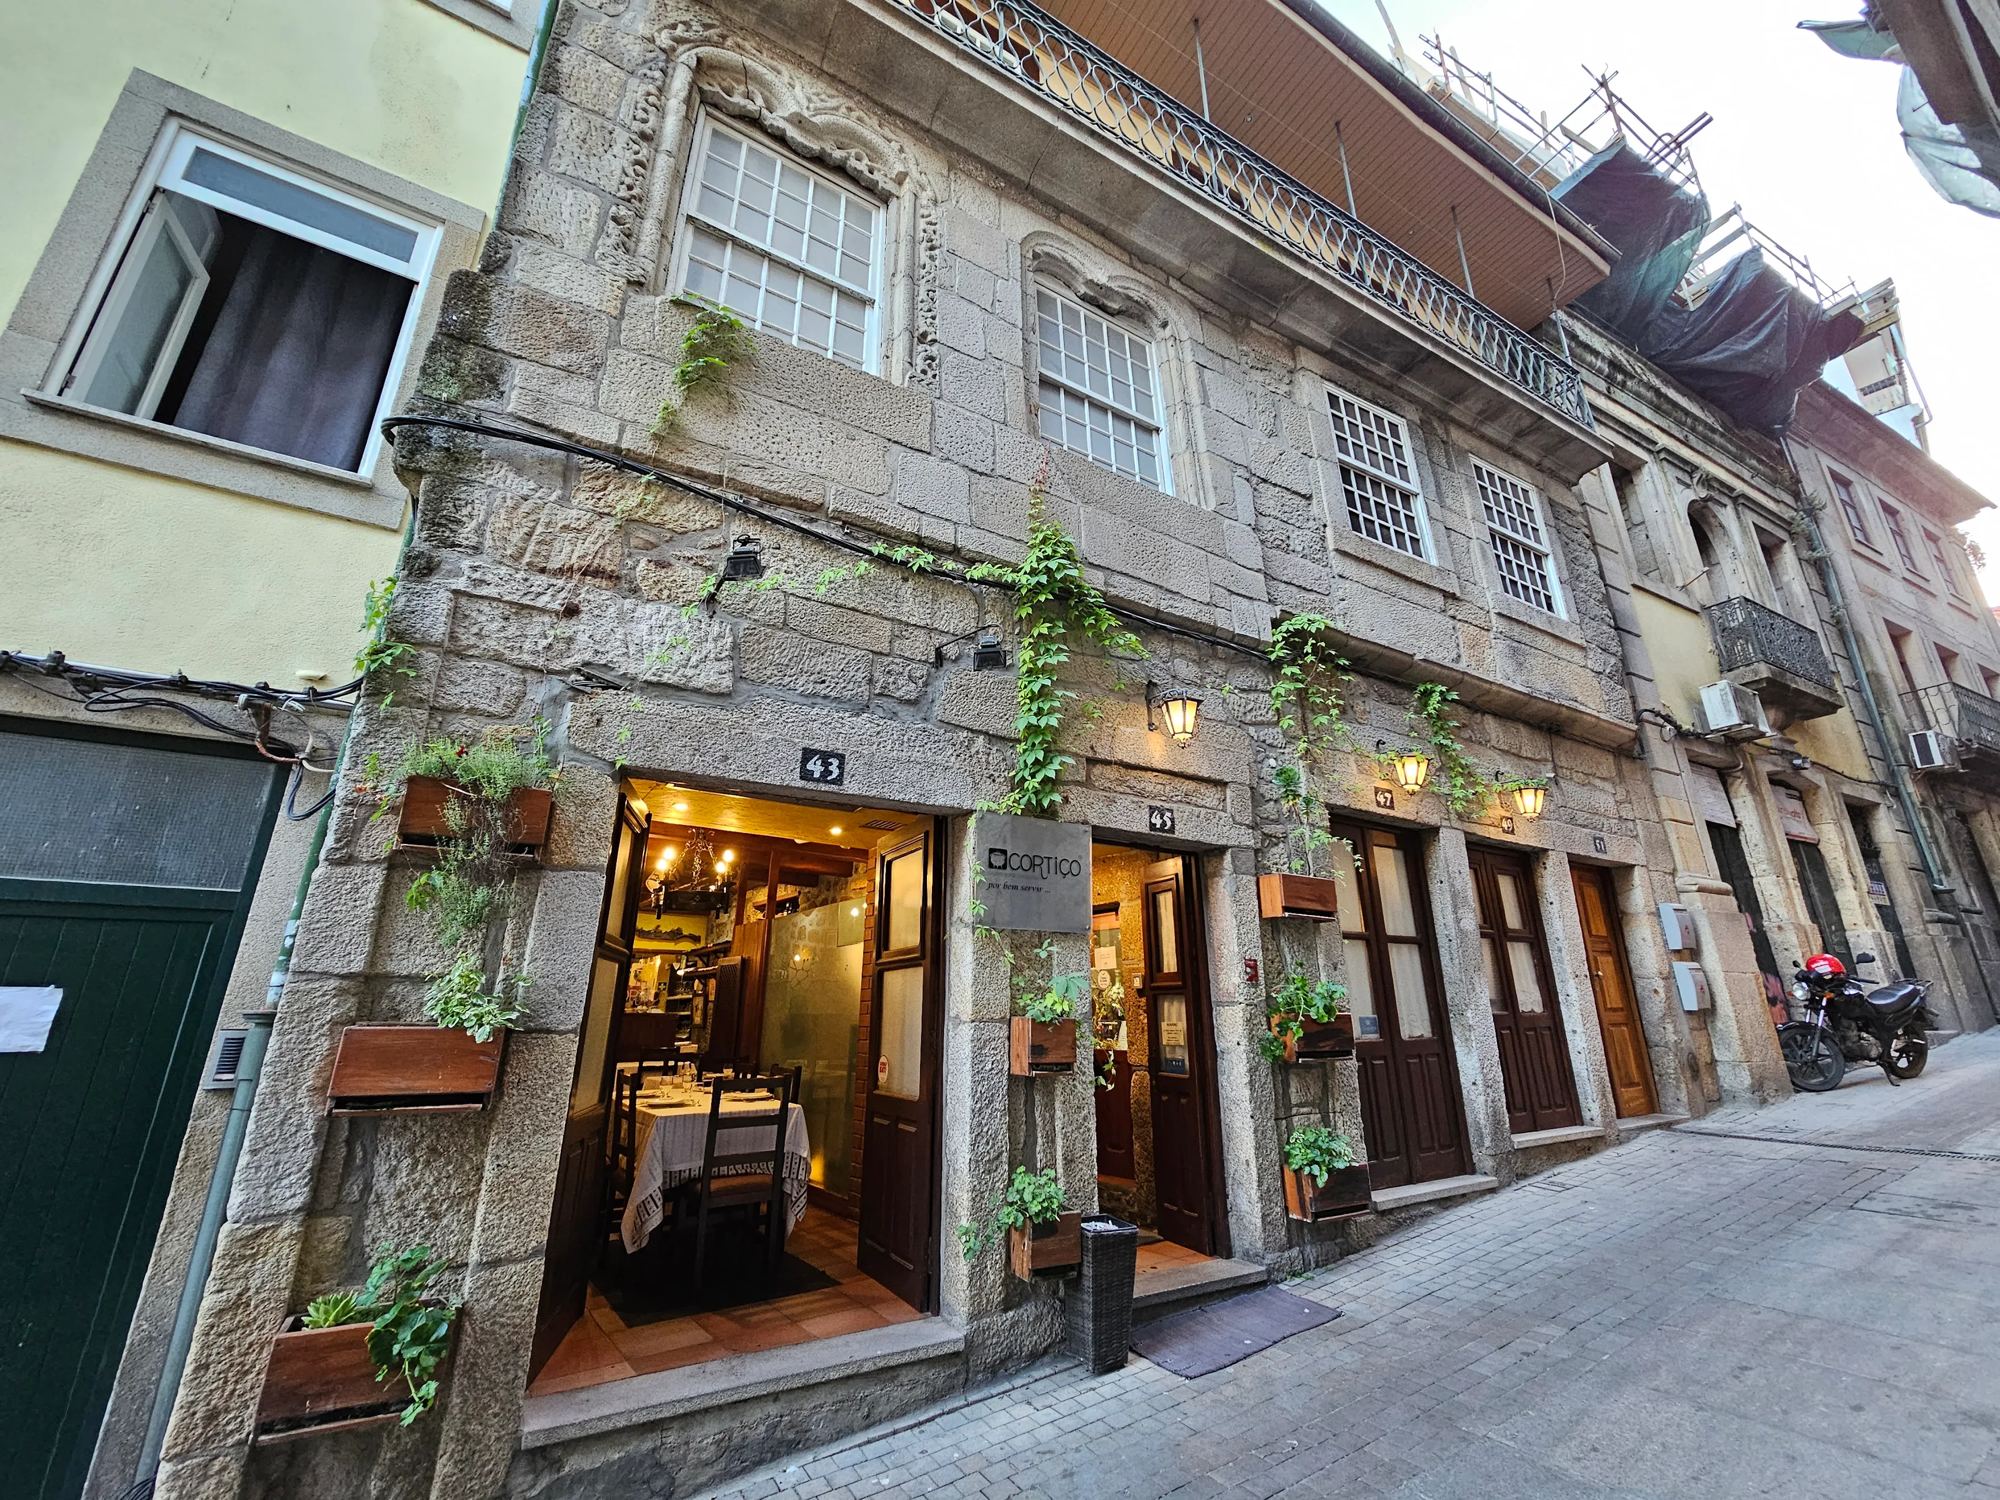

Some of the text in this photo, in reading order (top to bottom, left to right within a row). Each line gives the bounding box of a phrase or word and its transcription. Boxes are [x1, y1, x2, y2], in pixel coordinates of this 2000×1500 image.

[806, 755, 839, 780] 43
[1377, 790, 1392, 807] 47
[1151, 810, 1172, 829] 45
[1502, 817, 1513, 831] 49
[986, 882, 1002, 891] por
[1003, 881, 1019, 891] bem
